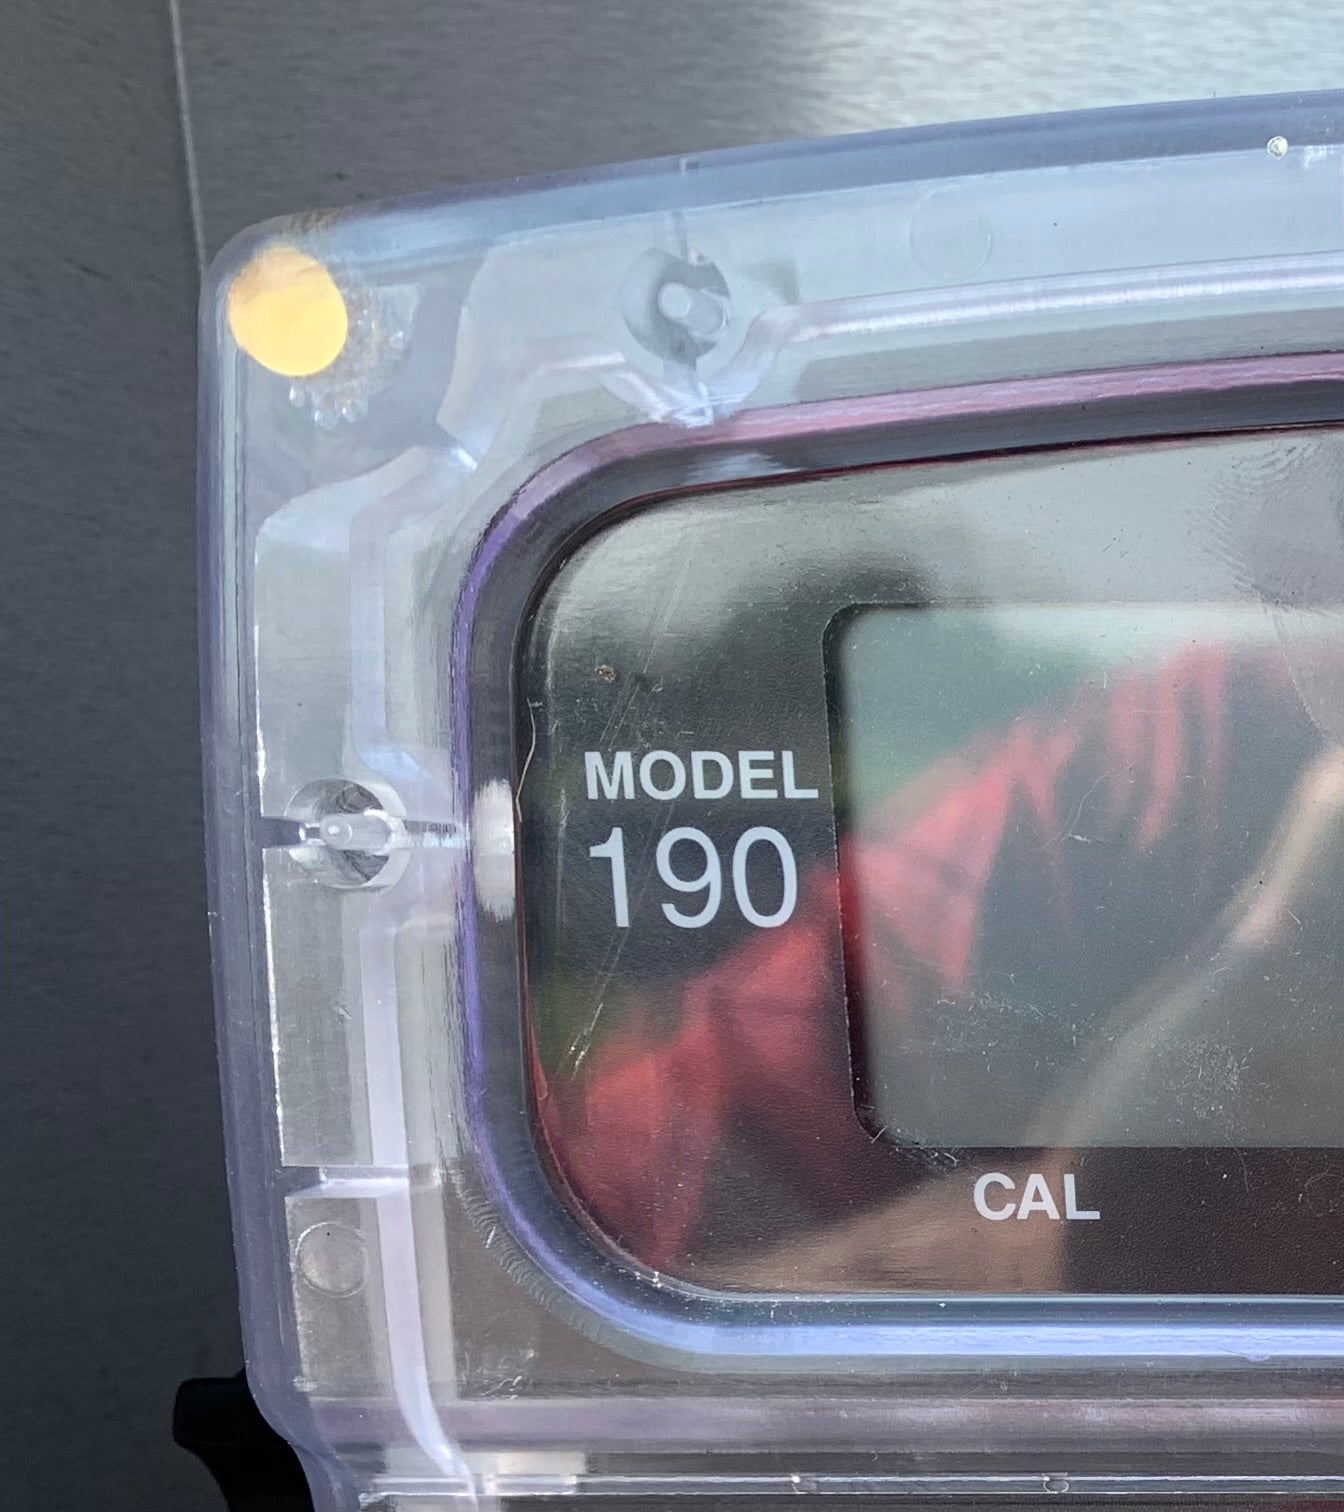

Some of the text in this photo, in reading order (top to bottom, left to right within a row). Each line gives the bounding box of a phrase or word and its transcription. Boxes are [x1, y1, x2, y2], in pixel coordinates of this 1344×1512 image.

[584, 750, 819, 800] MODEL
[588, 826, 798, 928] 190
[972, 1170, 1100, 1222] CAL
